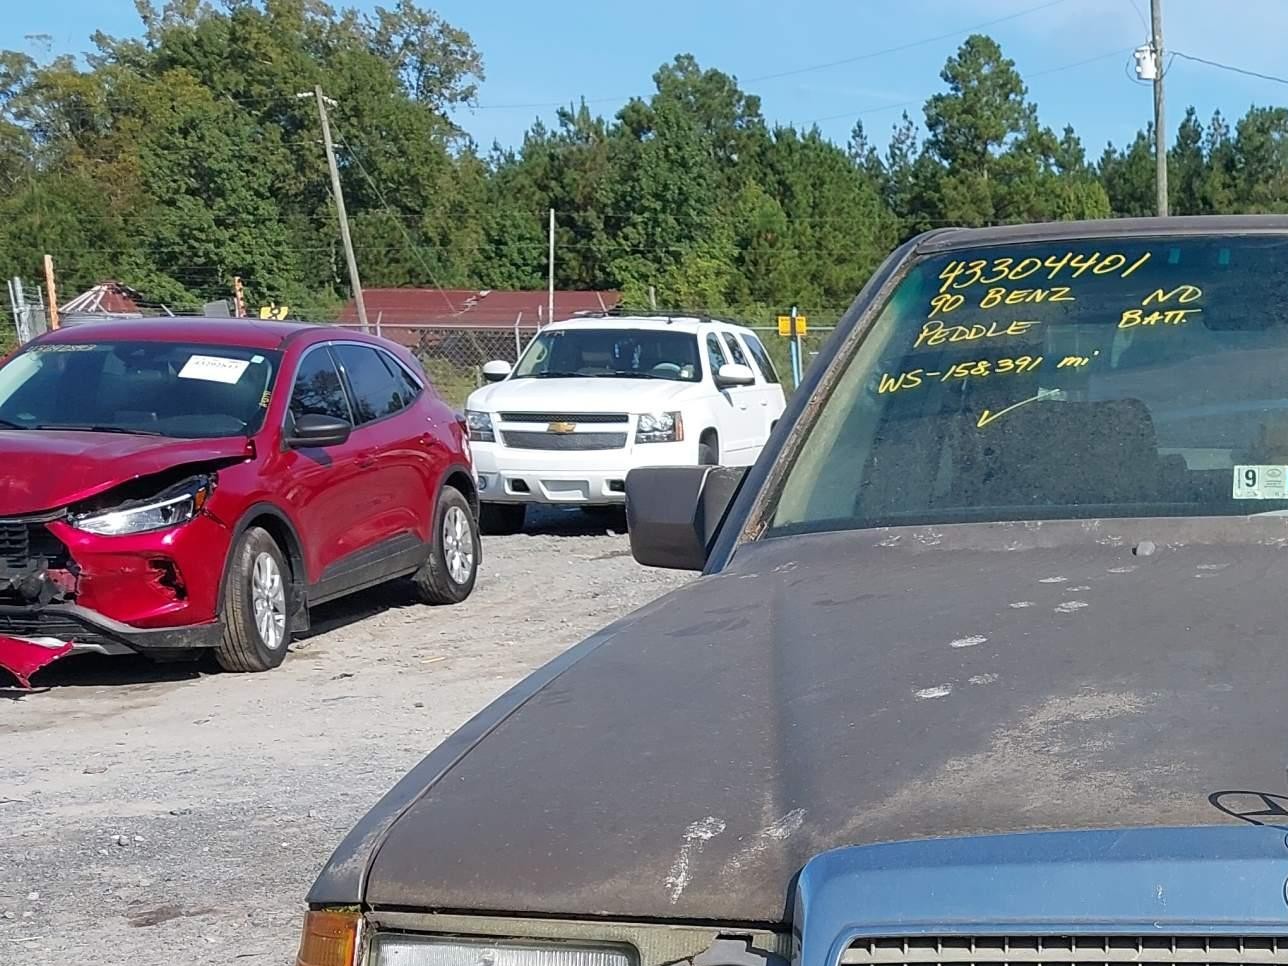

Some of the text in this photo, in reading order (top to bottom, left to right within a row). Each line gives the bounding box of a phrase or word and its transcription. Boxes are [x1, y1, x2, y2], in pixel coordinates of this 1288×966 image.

[938, 252, 1152, 293] 43304401
[927, 287, 1077, 318] 90 BENZ
[912, 319, 1042, 348] PEDDLE
[1244, 469, 1257, 488] 9
